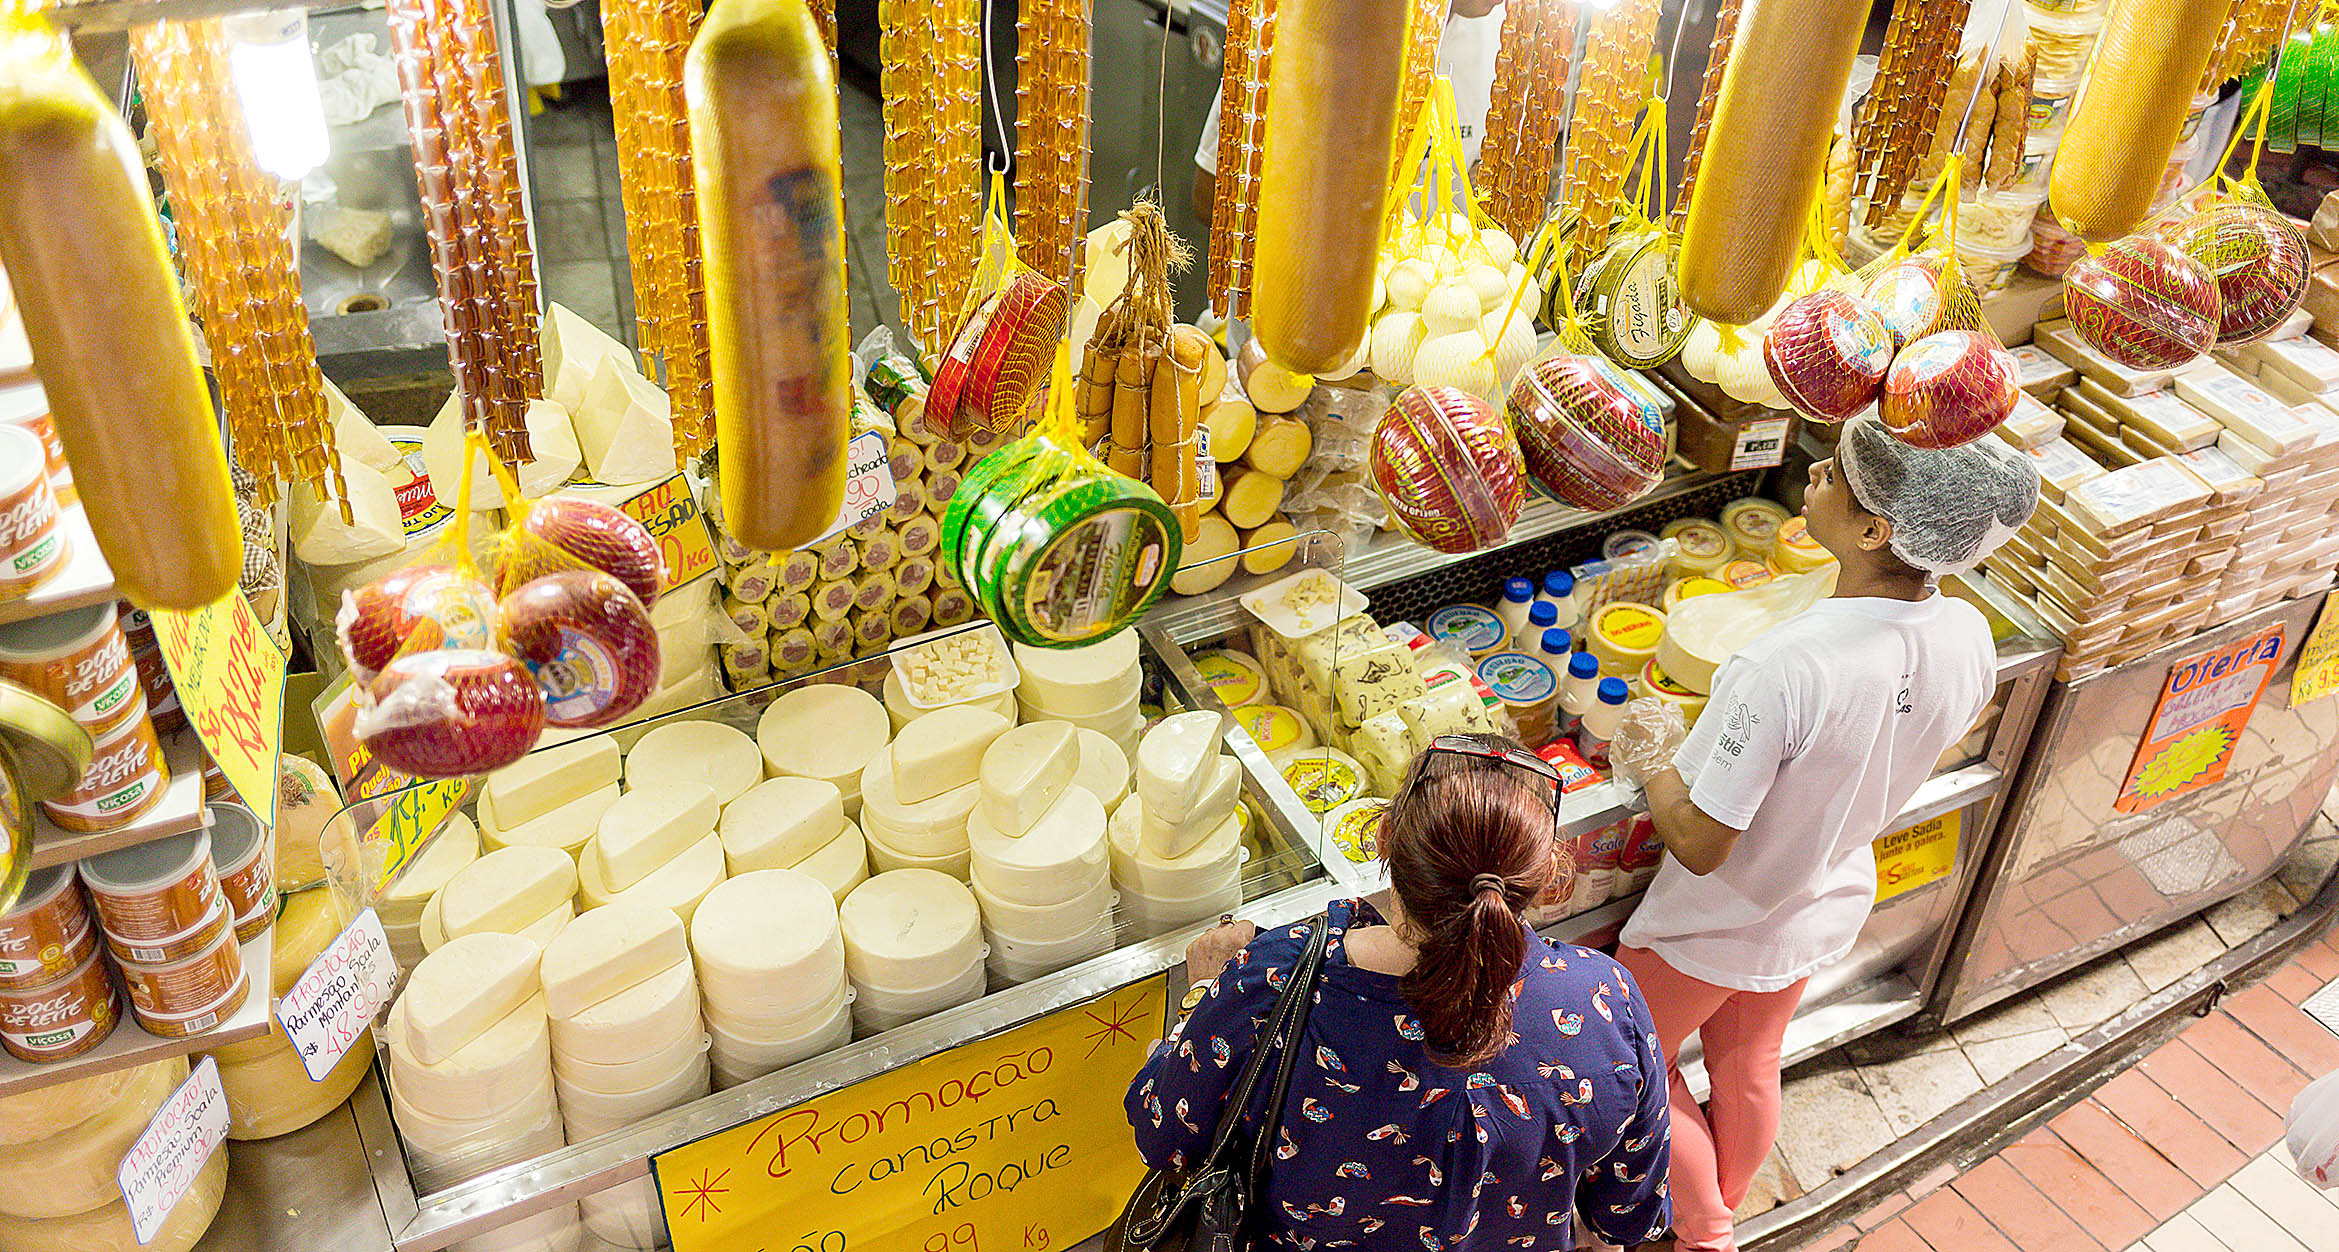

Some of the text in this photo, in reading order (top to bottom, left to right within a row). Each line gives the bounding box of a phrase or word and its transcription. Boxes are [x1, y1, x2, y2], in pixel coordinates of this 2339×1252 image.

[2171, 637, 2281, 693] Oferta
[1883, 819, 1943, 849] Leve Sadia
[287, 936, 381, 1036] Parmesão Scala
[291, 928, 366, 1011] PROMOÇÃO
[2, 995, 86, 1027] DE LEITE
[10, 991, 73, 1015] DOCE
[745, 1045, 1055, 1180] Promoção
[127, 1087, 219, 1203] Parmesão Scala
[154, 1125, 203, 1188] Premium
